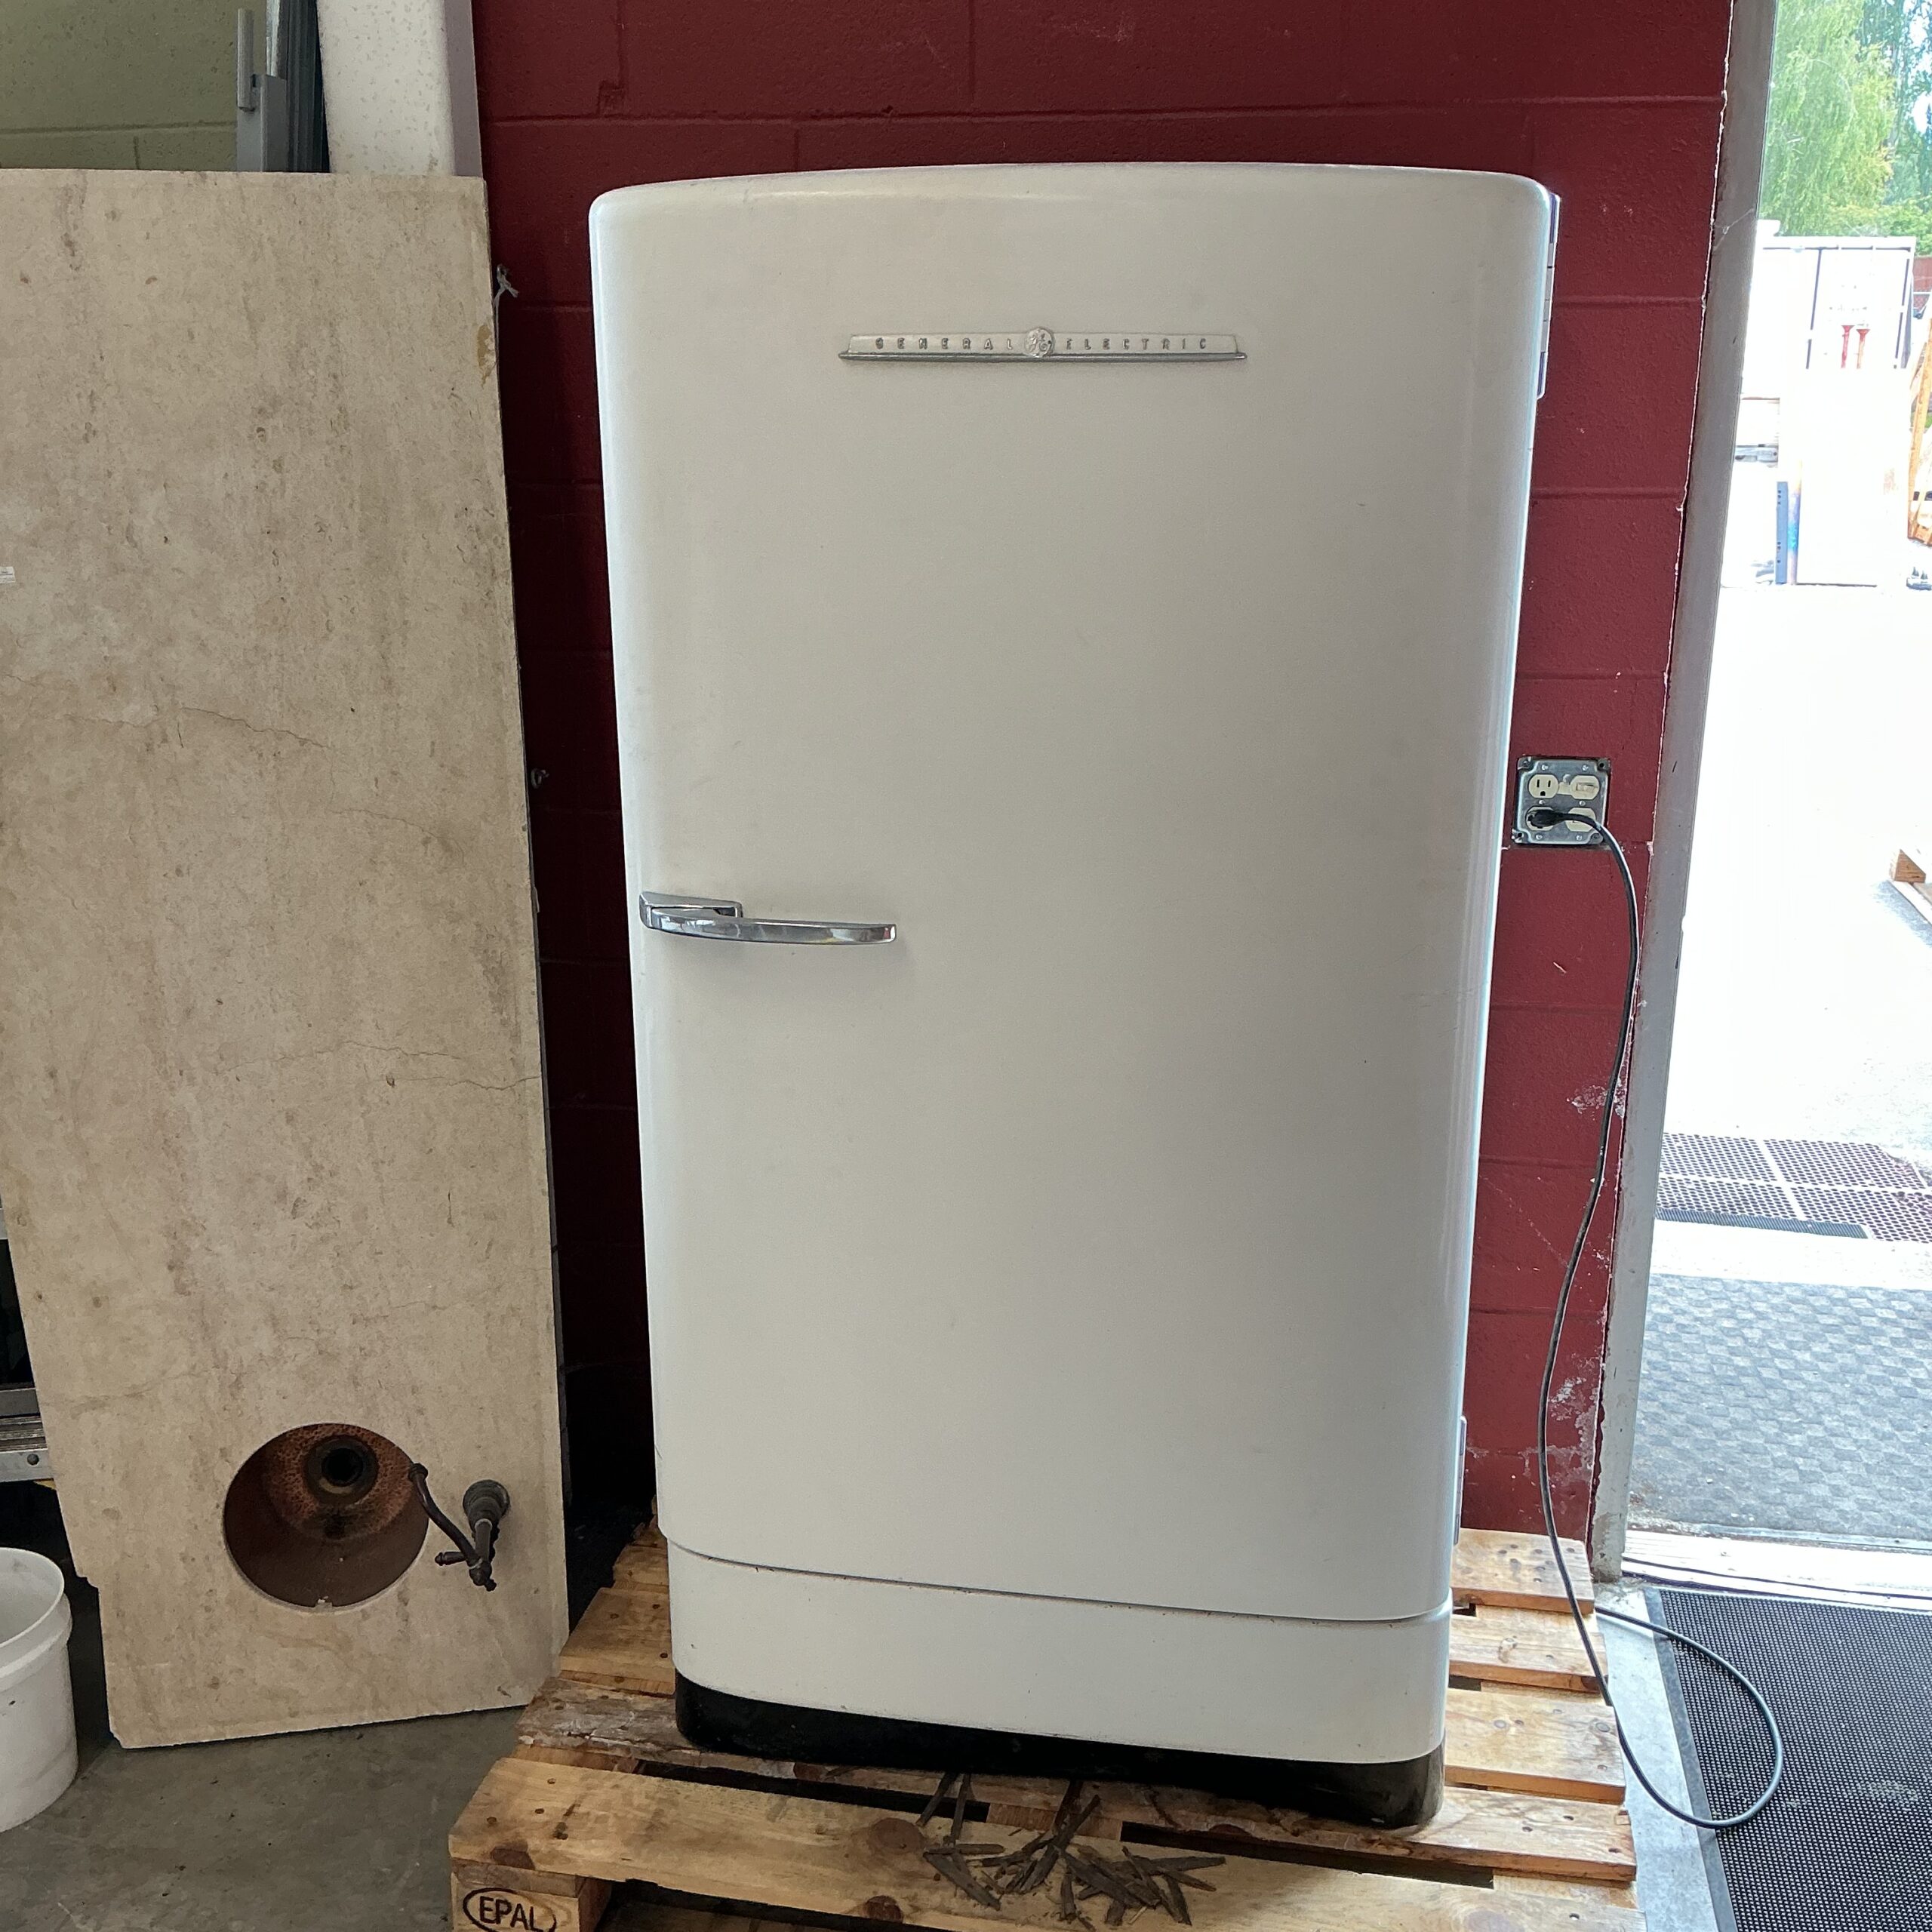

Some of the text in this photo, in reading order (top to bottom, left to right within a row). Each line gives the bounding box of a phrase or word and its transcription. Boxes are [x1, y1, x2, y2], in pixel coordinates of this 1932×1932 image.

[875, 337, 1014, 350] GENERAL
[1066, 337, 1207, 350] ELECTRIC
[479, 1896, 545, 1932] EPAL
